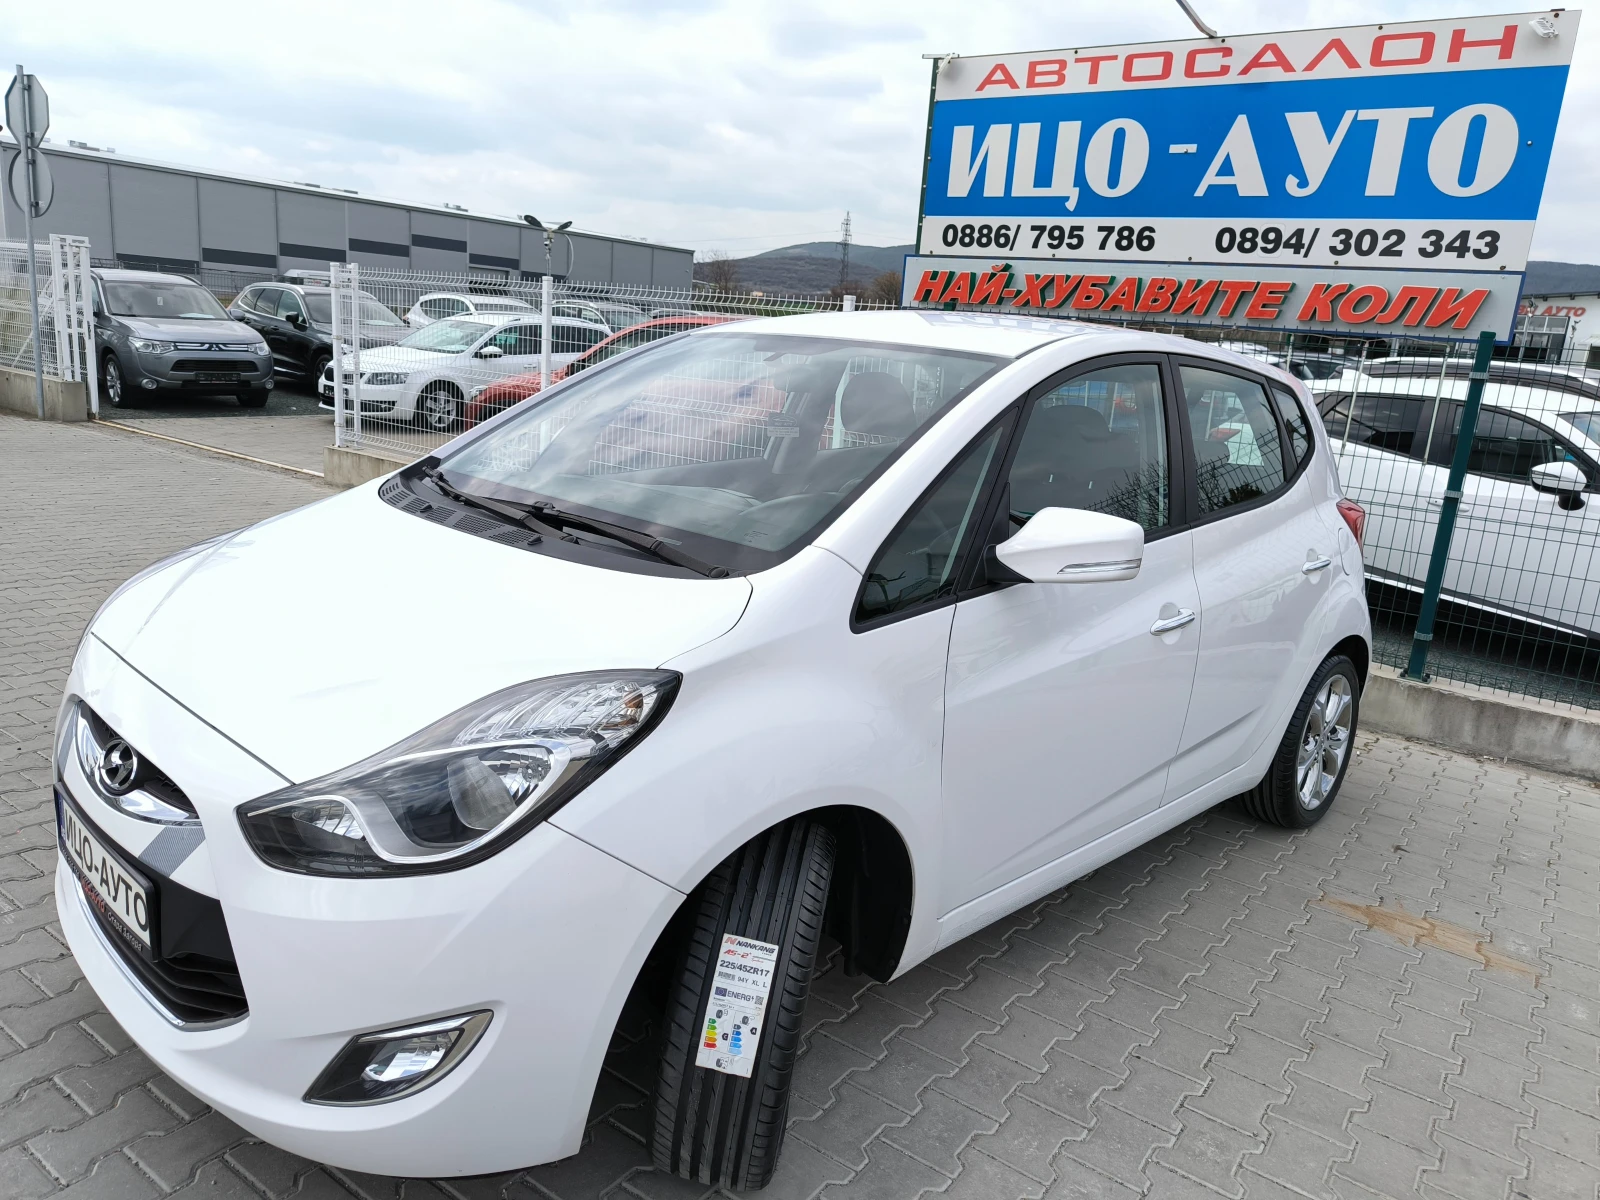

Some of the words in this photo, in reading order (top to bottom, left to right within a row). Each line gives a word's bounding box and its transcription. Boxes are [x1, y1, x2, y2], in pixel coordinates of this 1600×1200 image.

[975, 25, 1519, 92] АВТОСАЛОН
[941, 223, 1021, 251] 0886/
[1029, 224, 1085, 251] 795
[1096, 225, 1157, 252] 786
[1214, 226, 1320, 258] 0894/
[1328, 228, 1406, 257] 302
[1417, 229, 1501, 260] 343
[911, 262, 1294, 322] НАЙ-ХУБАВИТЕ
[1296, 282, 1491, 330] КОЛИ
[1541, 304, 1587, 318] АУТО
[65, 808, 149, 933] ИЦО-АУТО
[736, 940, 776, 954] NANKANG
[719, 959, 771, 978] 225/45ZR17
[737, 976, 749, 984] 94Y
[751, 979, 760, 987] XL
